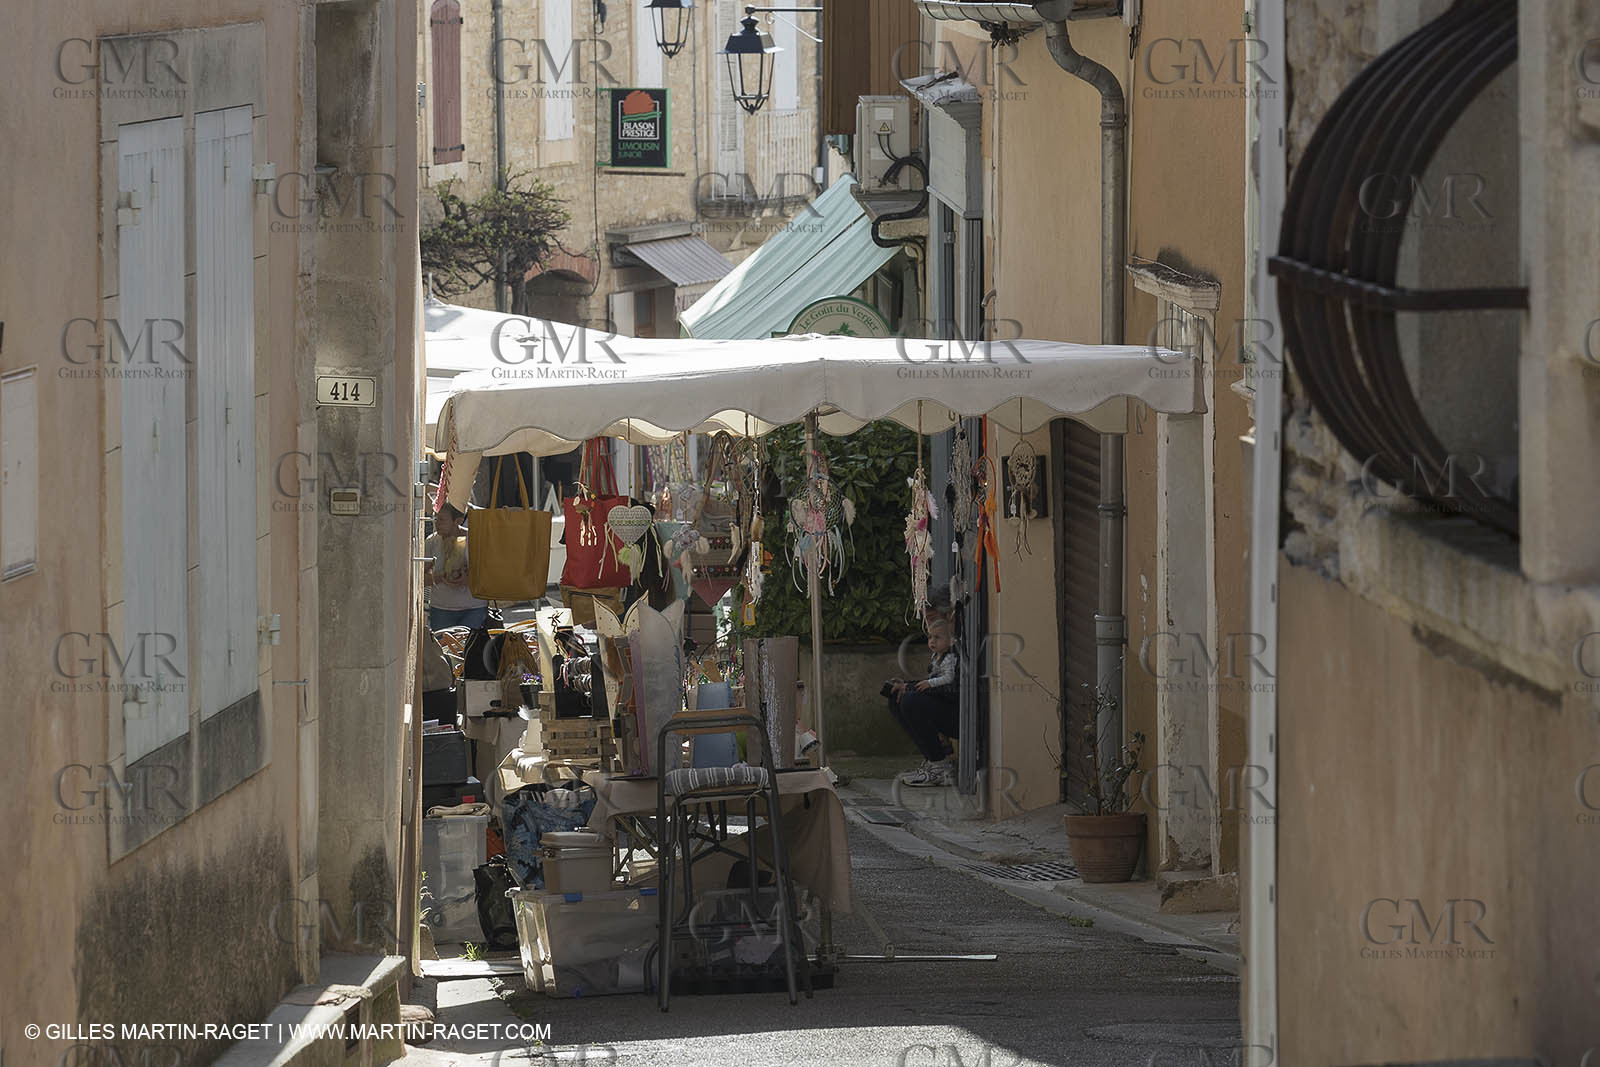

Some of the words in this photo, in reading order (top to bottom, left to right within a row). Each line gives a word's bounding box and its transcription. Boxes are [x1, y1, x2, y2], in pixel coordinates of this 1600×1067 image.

[623, 122, 655, 130] BLASON
[622, 129, 656, 137] PRESTIGE
[618, 142, 660, 151] LIMOUSIN
[799, 317, 812, 330] Le
[836, 304, 849, 313] du
[852, 307, 880, 331] Verger
[330, 382, 360, 401] 414
